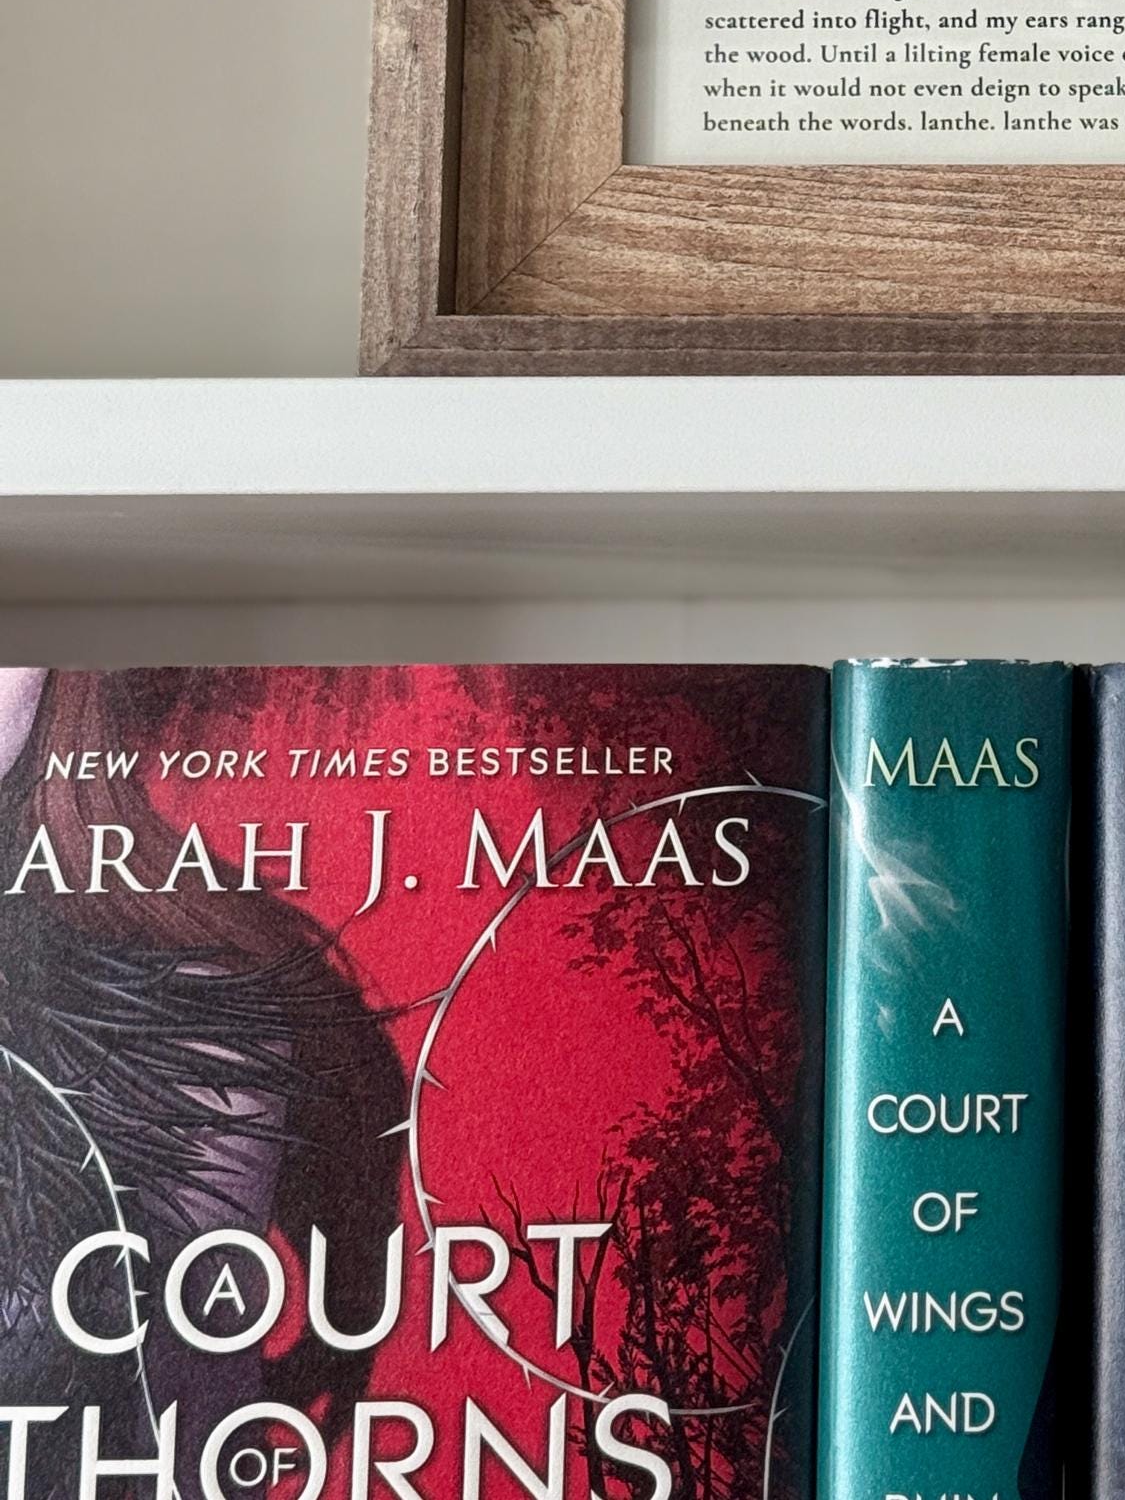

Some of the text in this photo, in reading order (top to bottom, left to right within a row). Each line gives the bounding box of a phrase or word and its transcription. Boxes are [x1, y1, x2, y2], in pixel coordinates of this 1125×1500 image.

[703, 77, 762, 98] when
[770, 79, 787, 97] it
[793, 76, 862, 97] would
[868, 83, 907, 97] not
[913, 84, 963, 97] even
[970, 75, 1031, 104] deign
[1038, 82, 1061, 97] to
[703, 110, 790, 132] beneath
[798, 110, 833, 132] the
[839, 110, 913, 131] words.
[1079, 117, 1119, 131] was
[45, 746, 675, 781] NEW YORK TIMES BESTSELLER
[862, 736, 1040, 791] MAAS
[4, 807, 753, 916] ARAH J. MAAS
[931, 998, 965, 1038] A
[866, 1093, 1029, 1135] COURT
[912, 1190, 979, 1234] OF
[51, 1223, 613, 1355] COURT
[203, 1262, 246, 1317] A
[863, 1290, 1026, 1334] WINGS
[888, 1391, 996, 1434] AND
[0, 1393, 673, 1500] THORNS
[229, 1447, 299, 1488] OF
